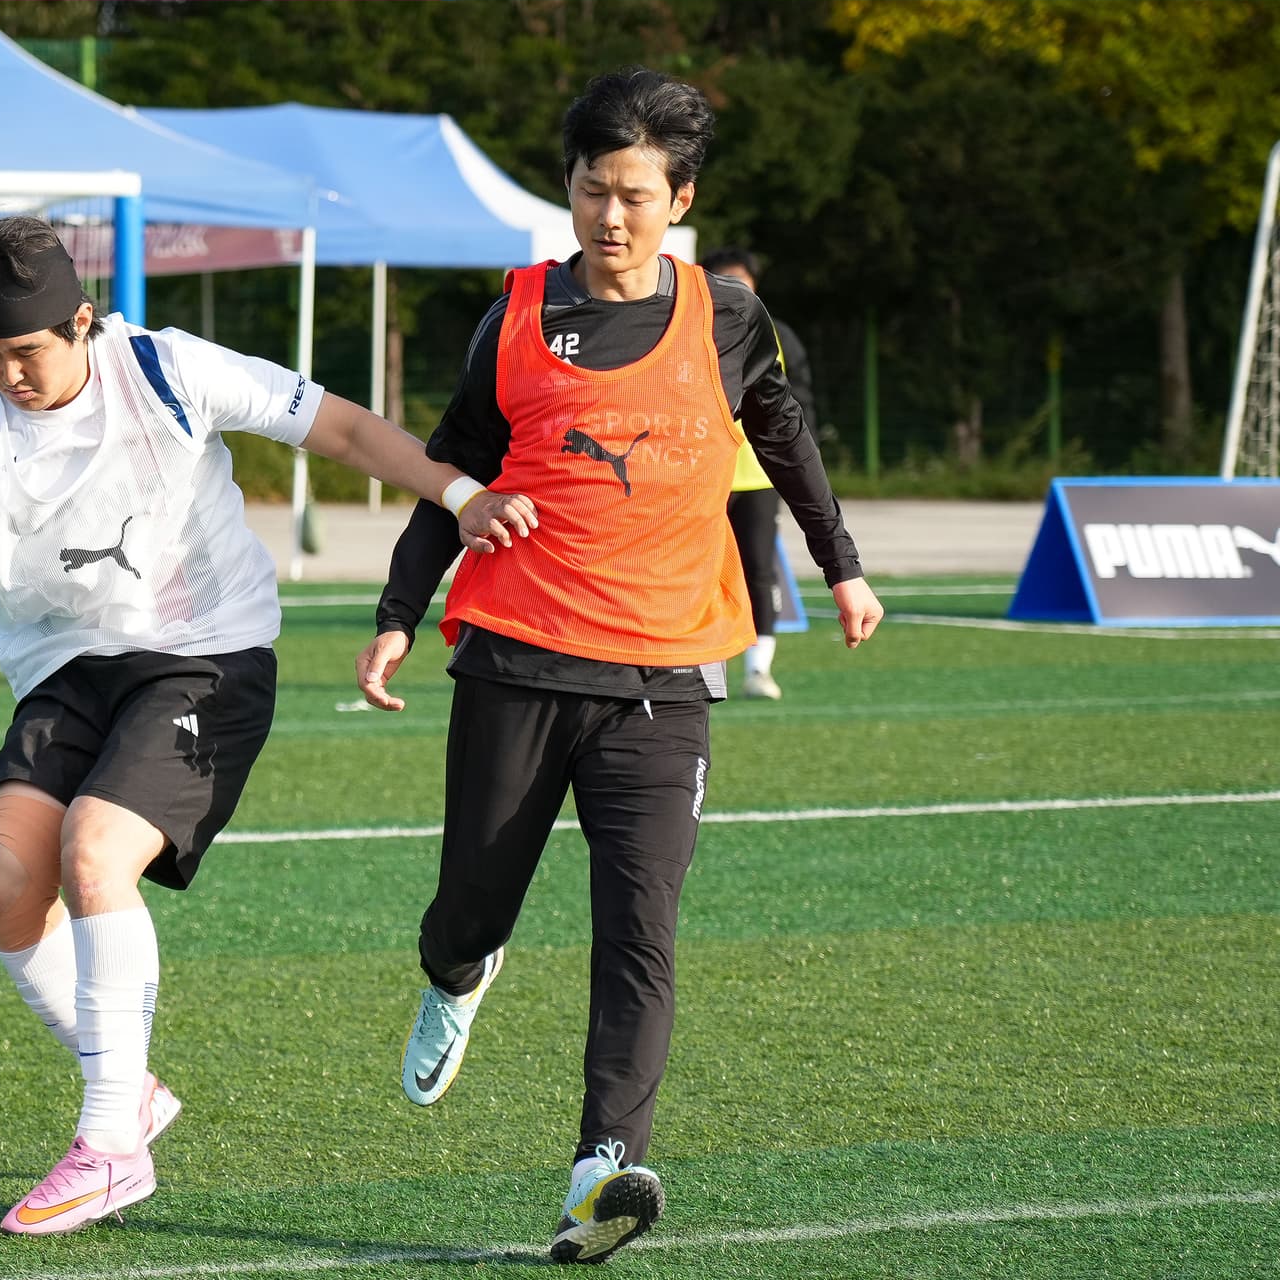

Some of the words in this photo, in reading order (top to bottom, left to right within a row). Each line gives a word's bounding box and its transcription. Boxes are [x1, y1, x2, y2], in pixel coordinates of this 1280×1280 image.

[549, 333, 580, 356] 42
[584, 411, 709, 440] SPORTS
[1083, 523, 1245, 579] PUMA
[692, 757, 707, 821] macron
